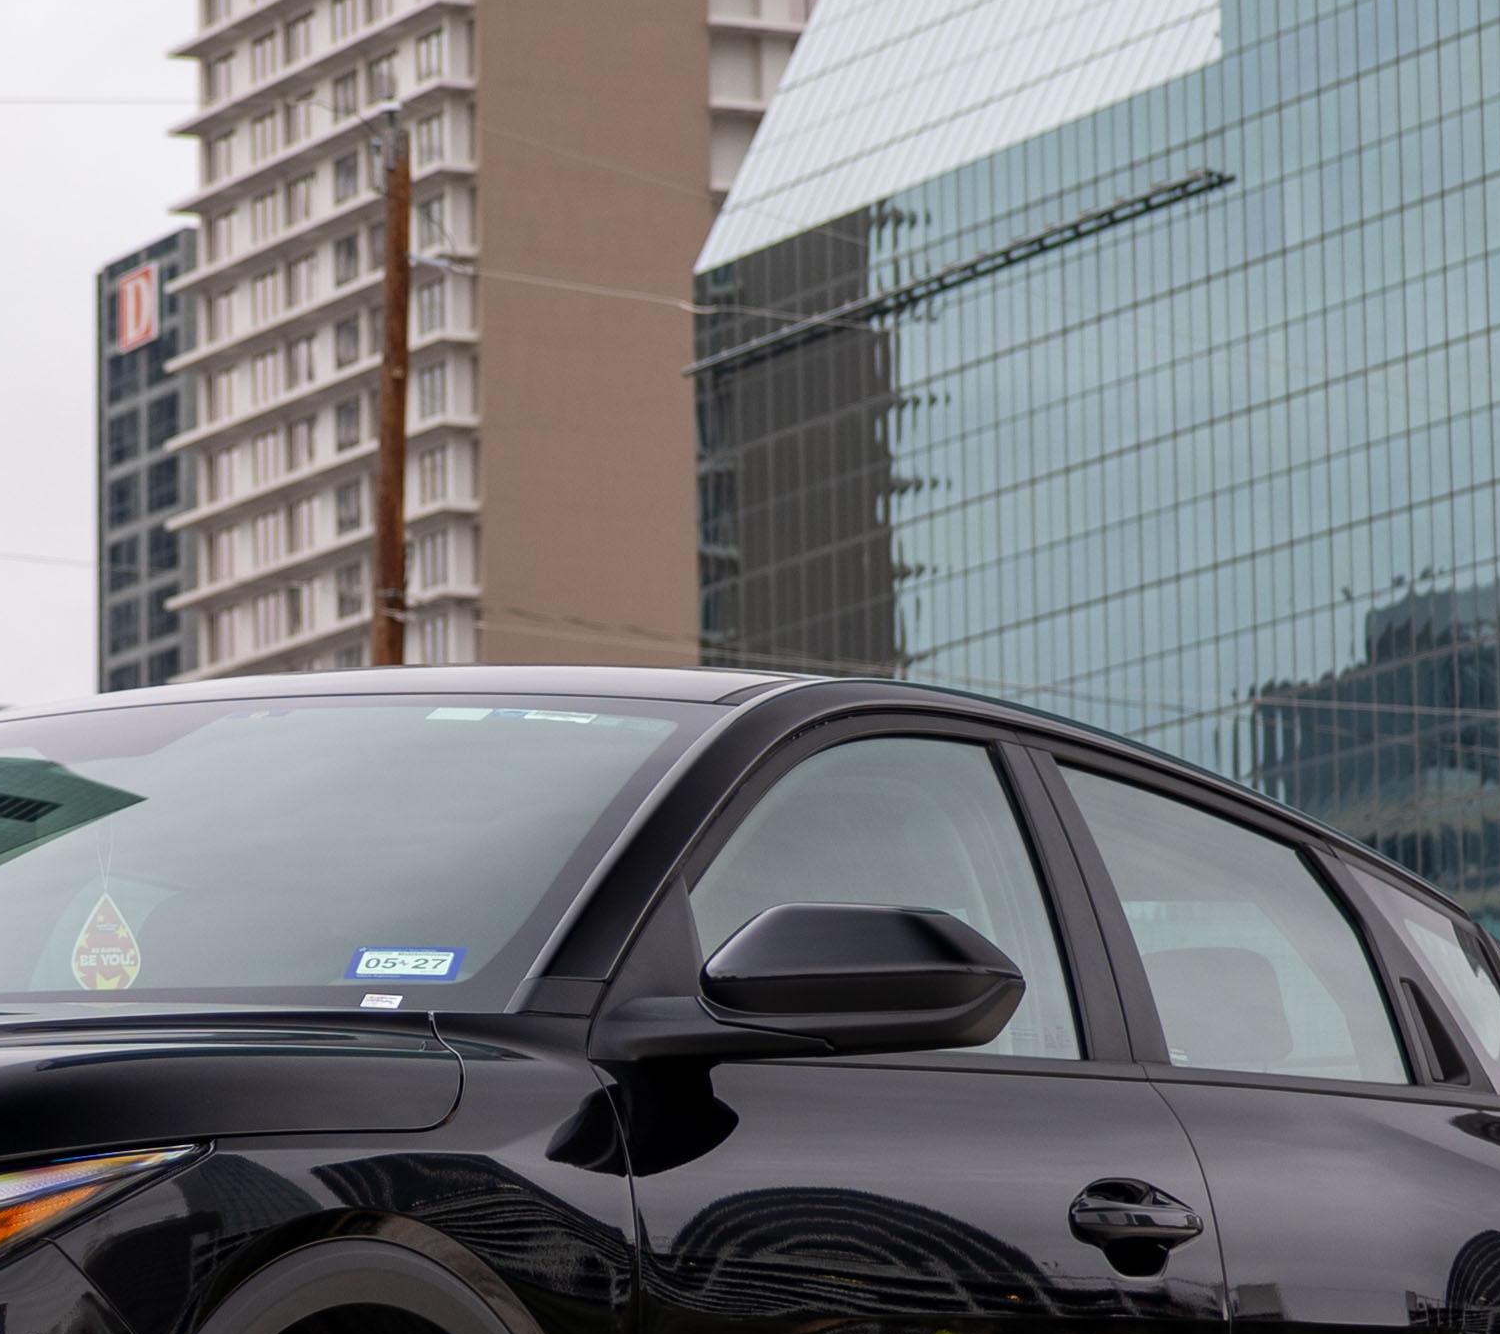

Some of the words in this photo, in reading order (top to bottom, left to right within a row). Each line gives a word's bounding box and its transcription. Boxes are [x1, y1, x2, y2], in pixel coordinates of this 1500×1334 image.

[126, 276, 152, 341] D
[365, 957, 398, 969] 05
[411, 958, 447, 970] 27
